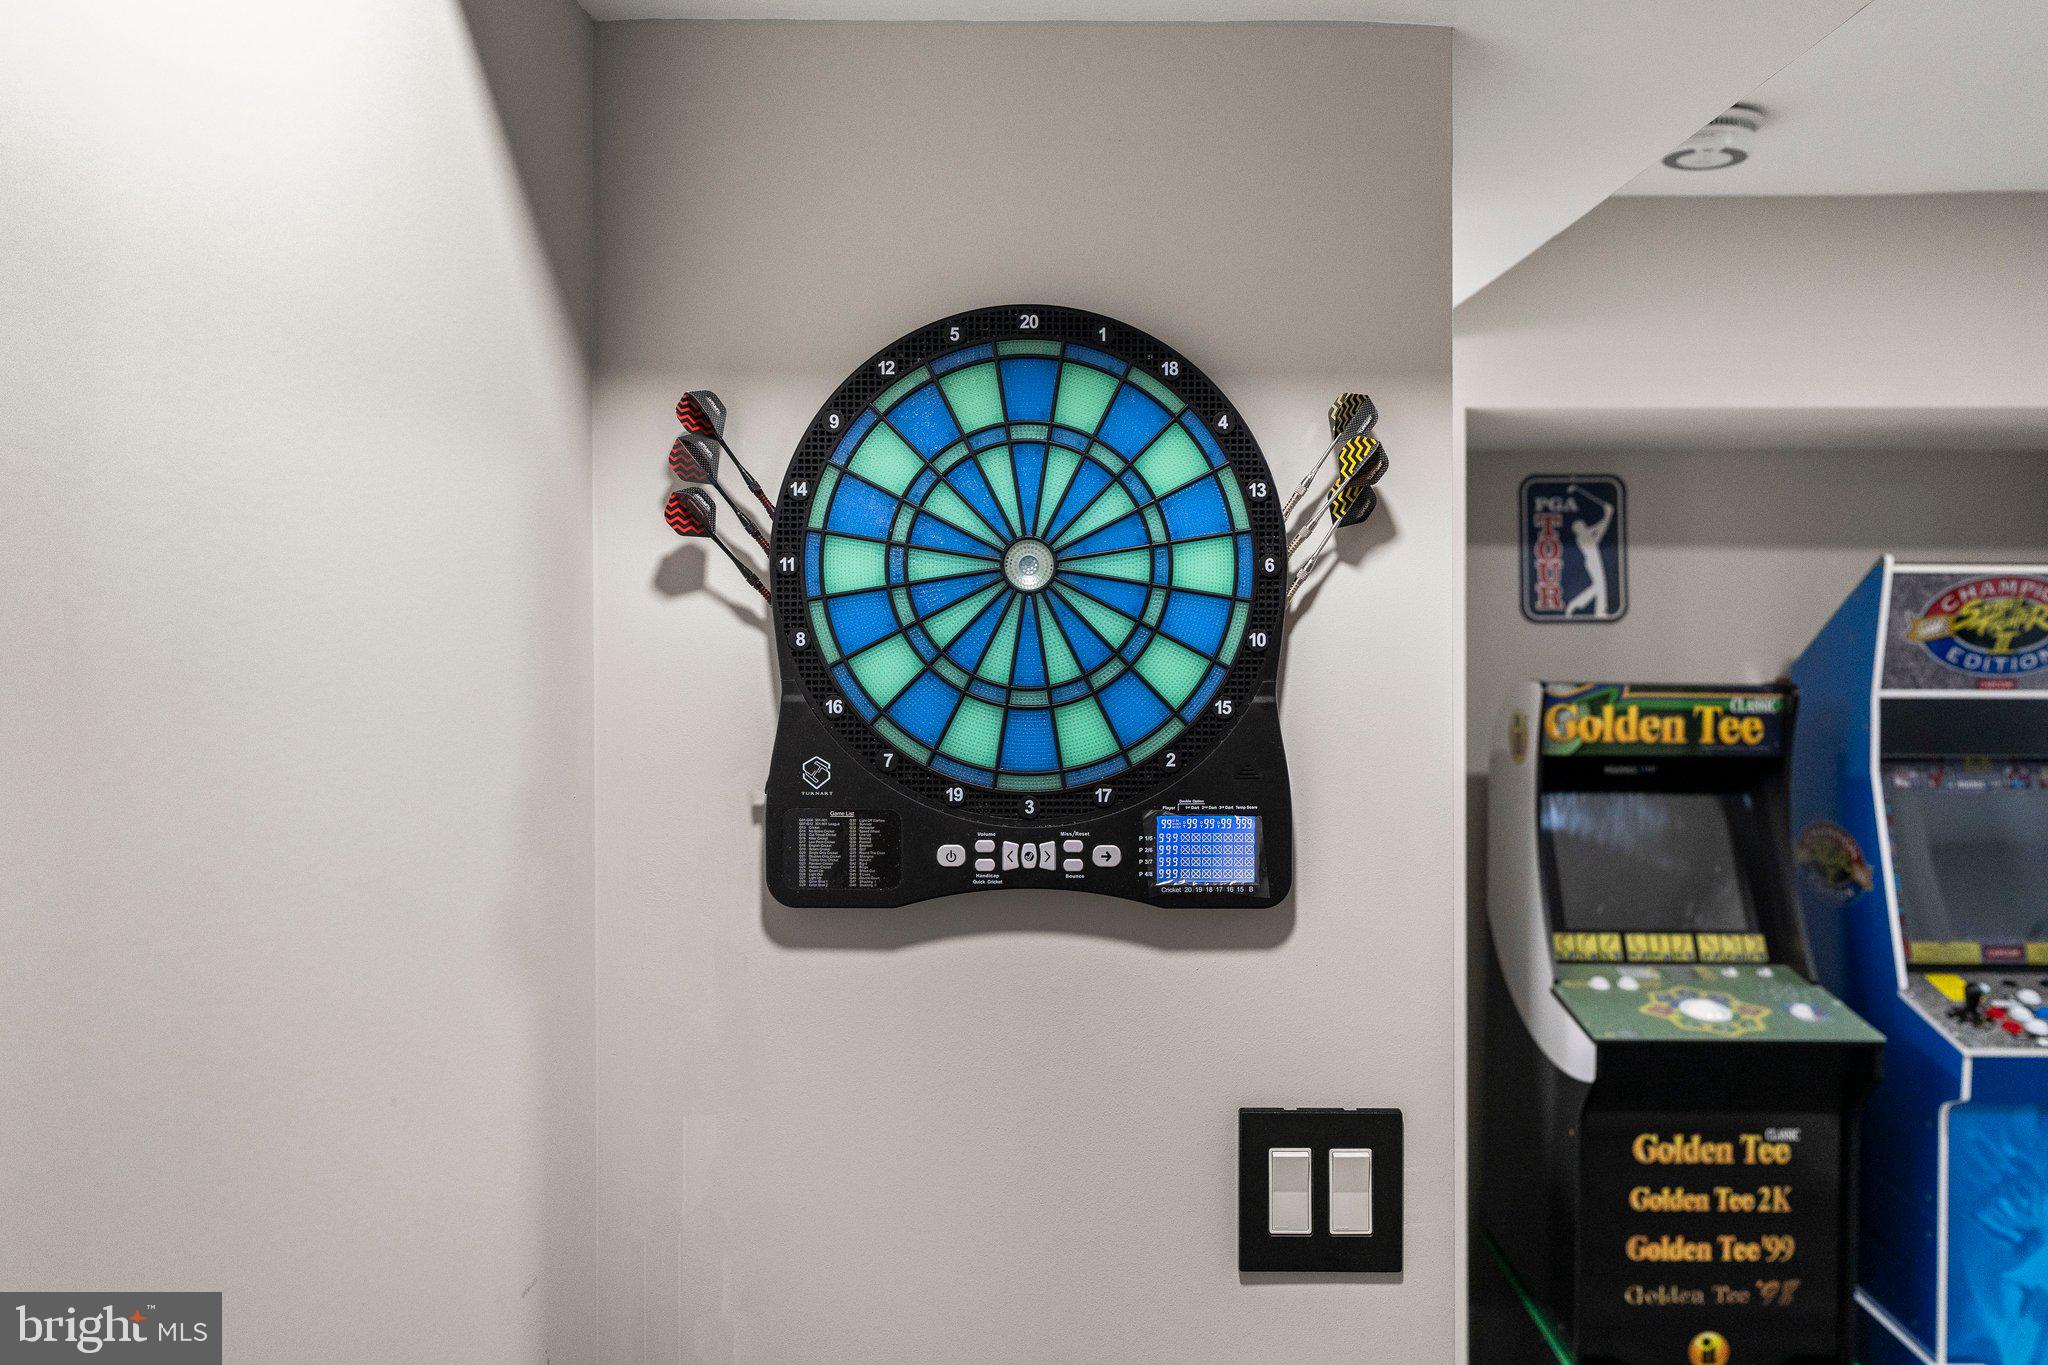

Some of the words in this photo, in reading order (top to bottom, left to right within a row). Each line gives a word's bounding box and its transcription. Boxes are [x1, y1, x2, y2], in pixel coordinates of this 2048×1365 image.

[1020, 315, 1038, 328] 20
[950, 327, 959, 341] 5
[1099, 328, 1105, 341] 1
[878, 361, 894, 374] 12
[1162, 362, 1178, 375] 18
[830, 414, 839, 428] 9
[1218, 415, 1228, 429] 4
[791, 482, 807, 496] 14
[1249, 483, 1266, 497] 13
[1534, 496, 1577, 512] PGA
[780, 557, 794, 571] 11
[1265, 558, 1274, 572] 6
[1533, 513, 1565, 611] TOUR
[796, 632, 805, 646] 8
[1249, 633, 1266, 647] 10
[826, 700, 842, 713] 16
[1215, 700, 1231, 714] 15
[1543, 703, 1688, 744] Golden
[1692, 705, 1765, 745] Tee
[884, 754, 893, 767] 7
[1166, 753, 1175, 766] 2
[946, 787, 963, 801] 19
[1096, 788, 1112, 802] 17
[1025, 800, 1034, 814] 3
[1161, 819, 1172, 829] 99
[1187, 818, 1198, 828] 99
[1204, 818, 1215, 828] 99
[1220, 818, 1232, 828] 99
[1235, 818, 1252, 829] 999
[1632, 1133, 1735, 1165] Golden
[1740, 1134, 1792, 1166] Tee
[1628, 1186, 1711, 1212] Golden
[1713, 1187, 1756, 1212] Tee
[1625, 1234, 1713, 1262] Golden
[1717, 1235, 1761, 1262] Tee
